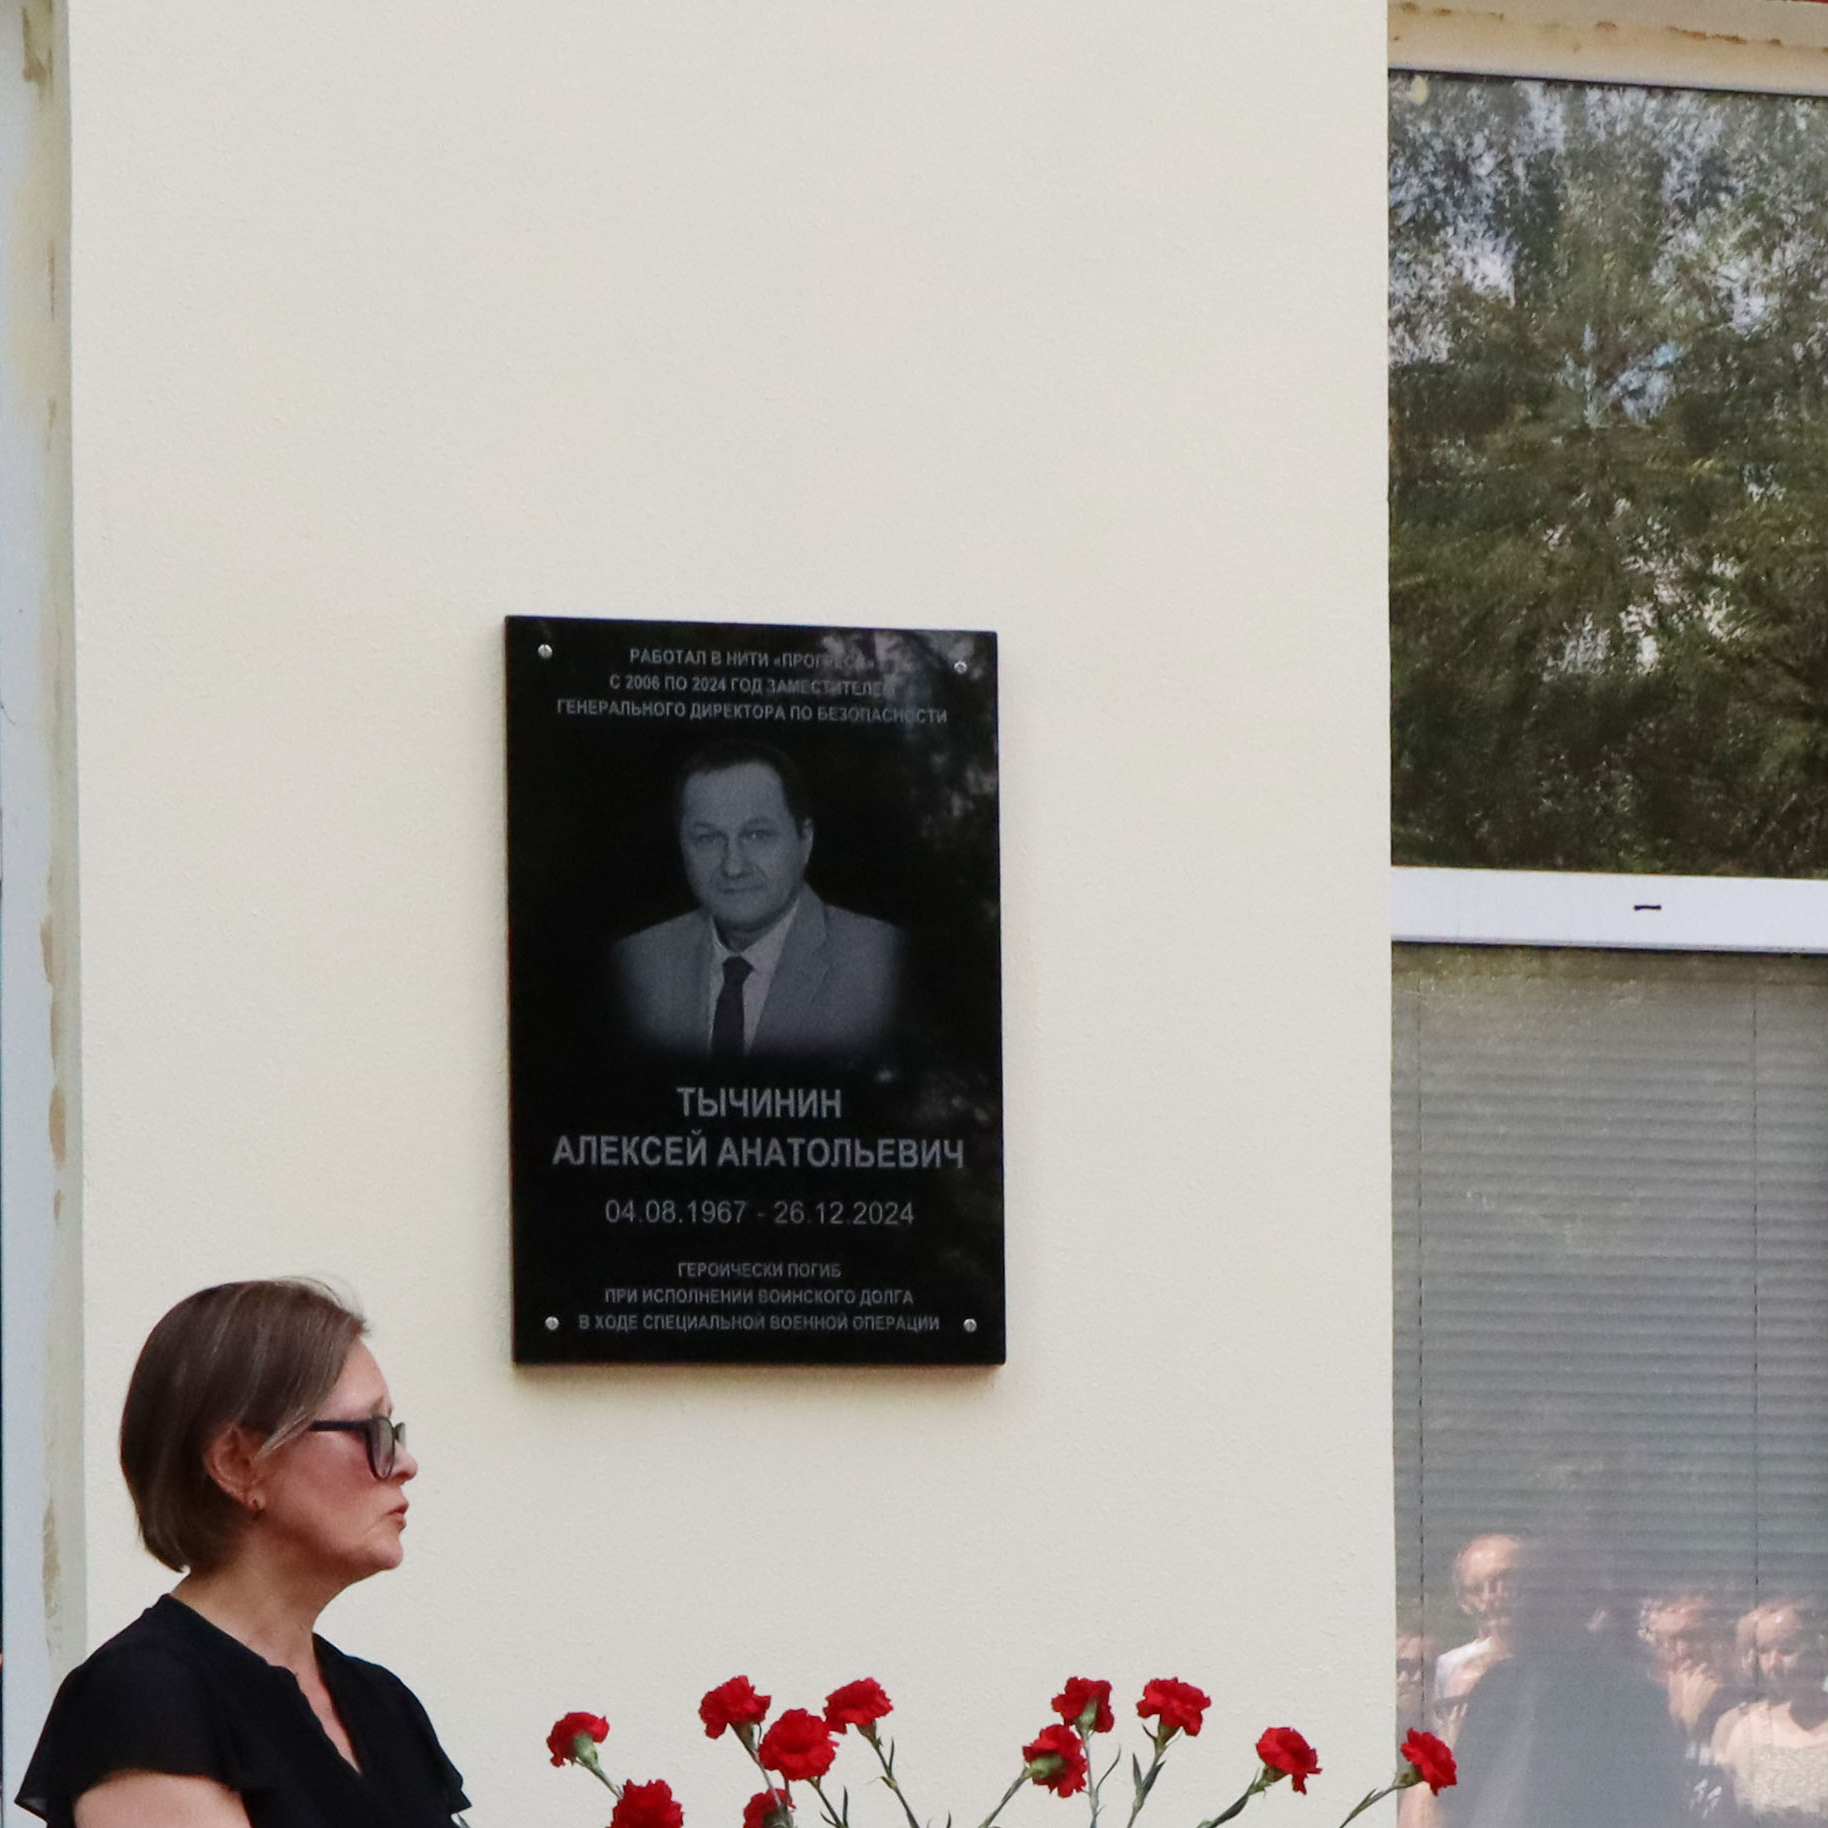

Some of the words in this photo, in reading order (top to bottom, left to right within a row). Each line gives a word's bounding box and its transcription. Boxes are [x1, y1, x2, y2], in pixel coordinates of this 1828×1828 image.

[629, 648, 707, 666] РАБОТАЛ
[711, 650, 722, 666] В
[726, 651, 770, 667] НИТИ
[609, 674, 621, 690] С
[625, 674, 660, 690] 2006
[664, 676, 688, 691] ПО
[692, 676, 726, 692] 2024
[730, 677, 763, 695] ГОД
[557, 699, 686, 718] ГЕНЕРАЛЬНОГО
[690, 702, 786, 720] ДИРЕКТОРА
[790, 705, 813, 720] ПО
[817, 706, 948, 724] БЕЗОПАСНОСТИ
[676, 1086, 842, 1119] ТЫЧИНИН
[552, 1128, 708, 1167] АЛЕКСЕЙ
[716, 1136, 964, 1169] АНАТОЛЬЕВИЧ
[604, 1199, 747, 1225] 04.08.1967
[773, 1200, 915, 1226] 26.12.2024
[677, 1262, 783, 1278] ГЕРОИЧЕСКИ
[787, 1262, 842, 1278] ПОГИБ
[604, 1288, 638, 1304] ПРИ
[642, 1288, 753, 1304] ИСПОЛНЕНИИ
[758, 1289, 856, 1305] ВОИНСКОГО
[859, 1289, 914, 1307] ДОЛГА
[578, 1314, 590, 1330] В
[594, 1314, 638, 1333] ХОДЕ
[642, 1312, 765, 1333] СПЕЦИАЛЬНОЙ
[769, 1312, 848, 1331] ВОЕННОЙ
[852, 1315, 940, 1333] ОПЕРАЦИИ
